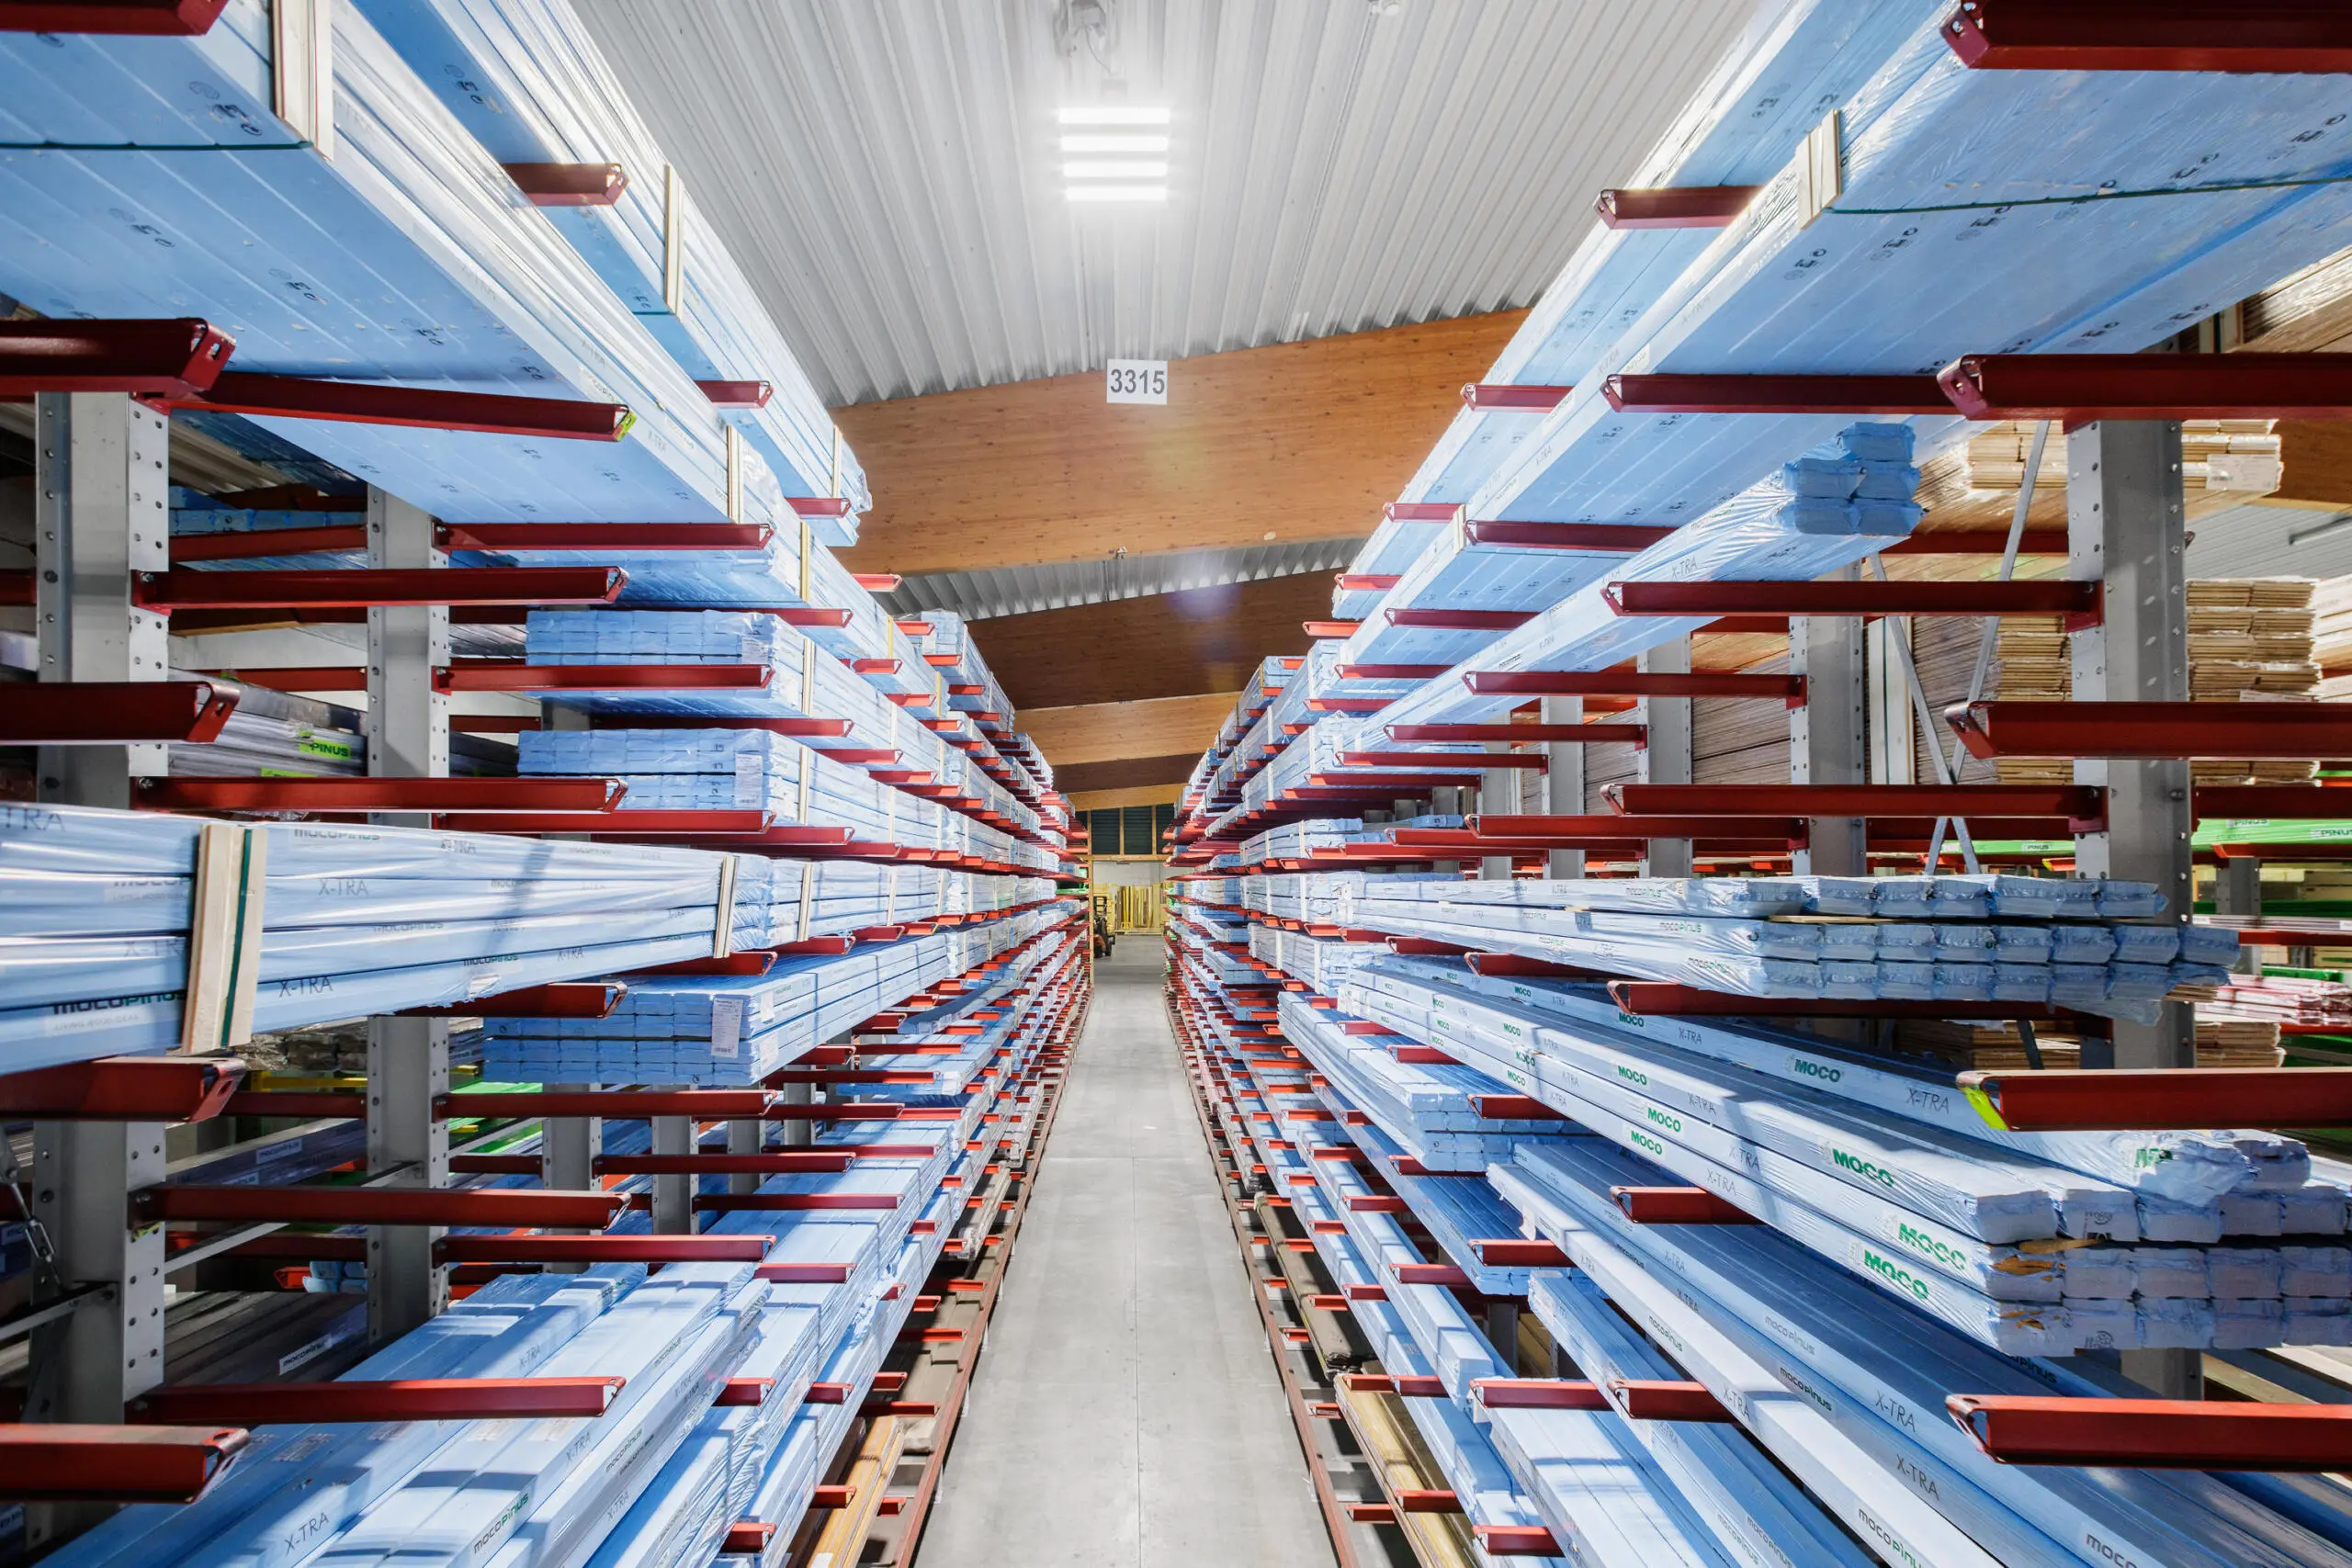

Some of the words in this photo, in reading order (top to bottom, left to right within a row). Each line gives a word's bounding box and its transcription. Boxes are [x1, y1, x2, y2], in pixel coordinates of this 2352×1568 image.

[1110, 368, 1166, 395] 3315
[1671, 557, 1697, 581] X-TRA
[311, 742, 349, 757] PINUS
[319, 878, 369, 897] X-TRA
[279, 976, 334, 998] X-TRA
[1514, 986, 1532, 997] MOCO
[1503, 1022, 1521, 1037] MOCO
[1618, 1011, 1645, 1028] MOCO
[1679, 1027, 1702, 1043] X-TRA
[1507, 1069, 1525, 1087] MOCO
[1618, 1066, 1648, 1086] MOCO
[1794, 1058, 1841, 1083] MOCO
[1688, 1092, 1716, 1115] X-TRA
[1905, 1087, 1950, 1114] X-TRA
[1647, 1107, 1681, 1133] MOCO
[1631, 1130, 1663, 1155] MOCO
[1832, 1147, 1894, 1188] MOCO
[1706, 1168, 1737, 1196] X-TRA
[1898, 1222, 1967, 1272] MOCO
[1864, 1248, 1929, 1300] MOCO
[1648, 1314, 1683, 1352] mocopinus
[1764, 1314, 1816, 1355] mocopinus
[1723, 1383, 1750, 1421] X-TRA
[1780, 1367, 1832, 1412] mocopinus
[1875, 1388, 1916, 1433] X-TRA
[566, 1432, 591, 1464] X-TRA
[1896, 1453, 1940, 1501] X-TRA
[285, 1512, 330, 1556] X-TRA
[473, 1493, 529, 1554] mocopinus
